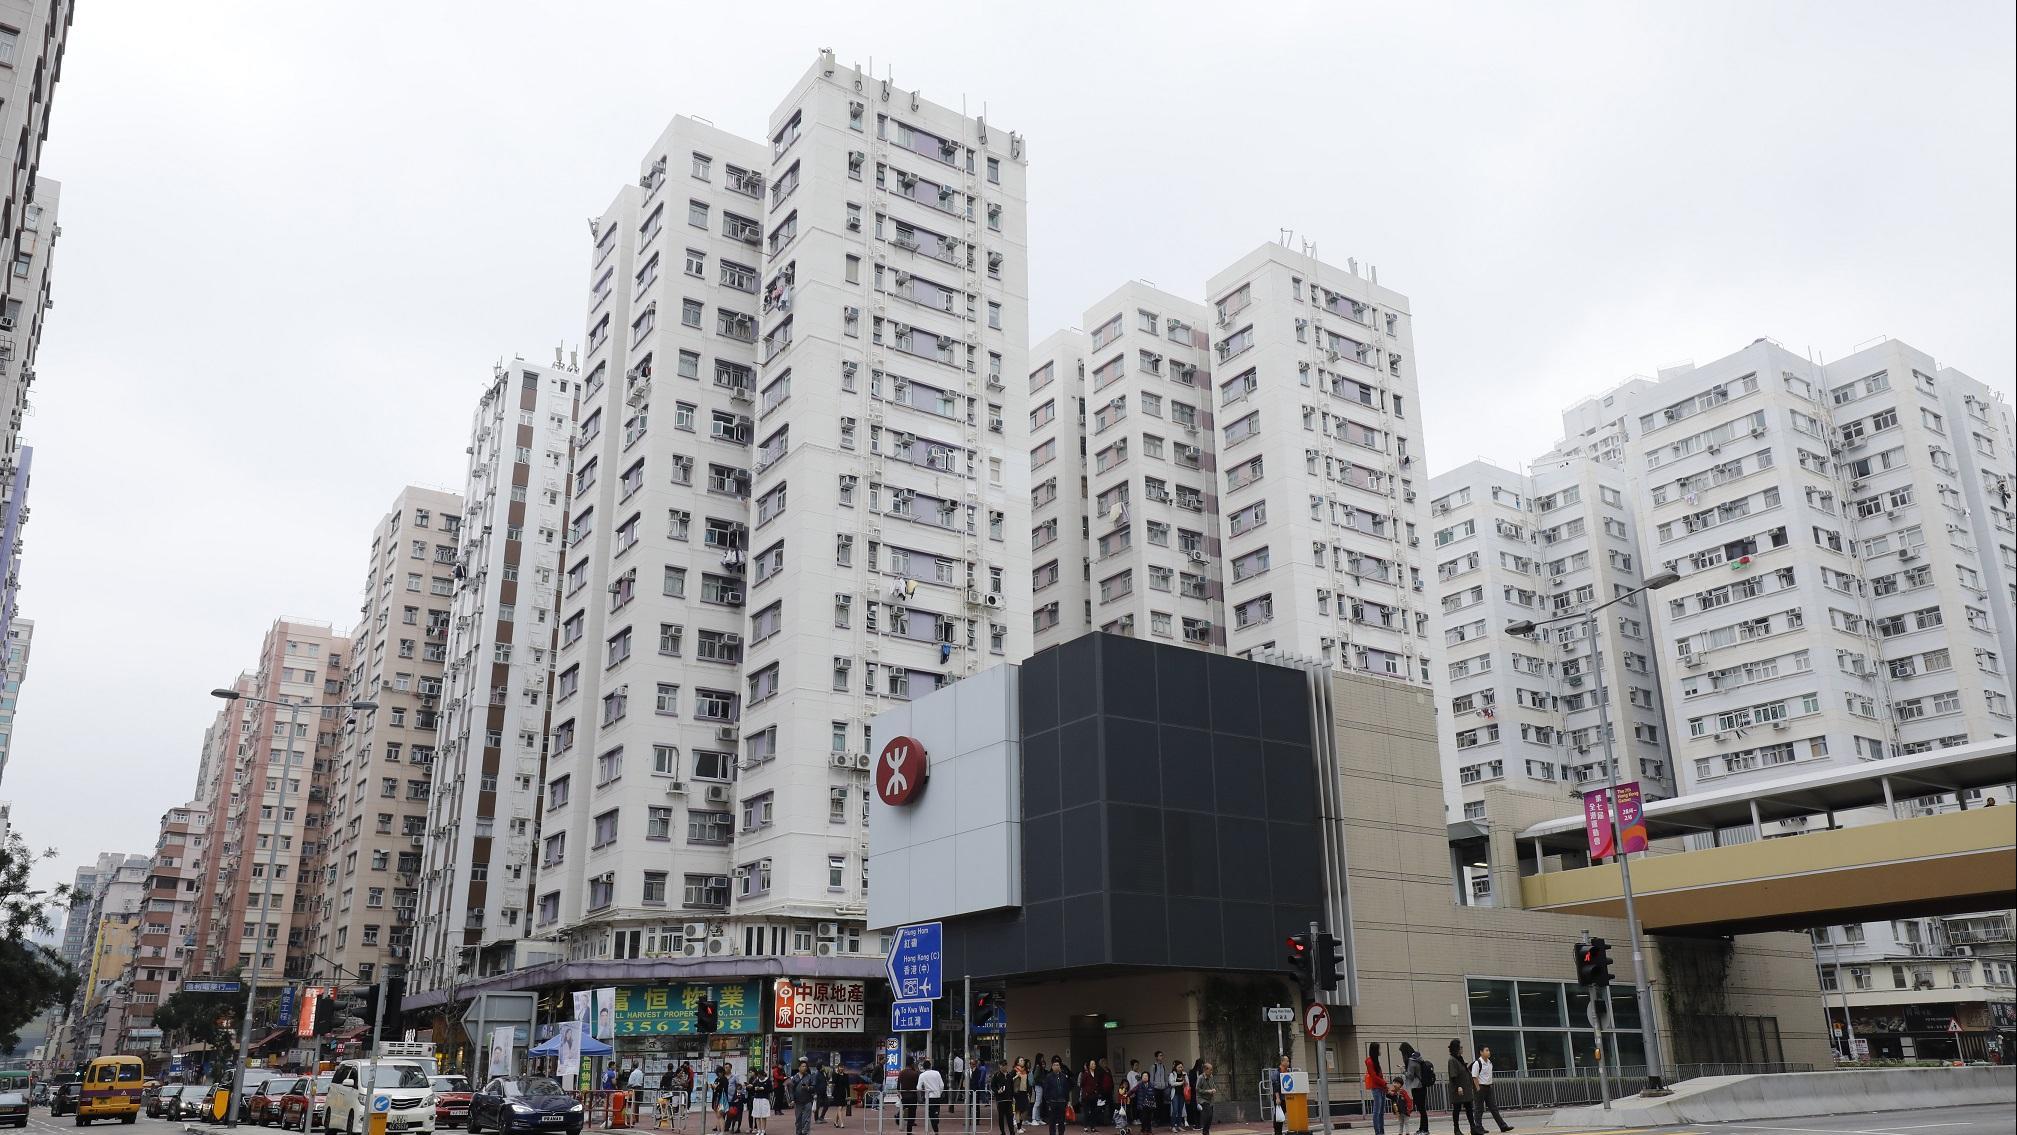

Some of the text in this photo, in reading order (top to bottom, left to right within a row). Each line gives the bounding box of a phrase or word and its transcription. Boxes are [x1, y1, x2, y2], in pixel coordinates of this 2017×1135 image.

[904, 927, 929, 937] Hung Hom
[903, 951, 940, 963] Hong Kong (C)
[796, 982, 864, 1003] 中原地產
[796, 1003, 864, 1016] CENTALINE
[919, 1005, 930, 1013] Wan
[614, 1021, 669, 1032] 356
[795, 1016, 860, 1029] PROPERTY
[900, 1016, 921, 1027] 土瓜灣
